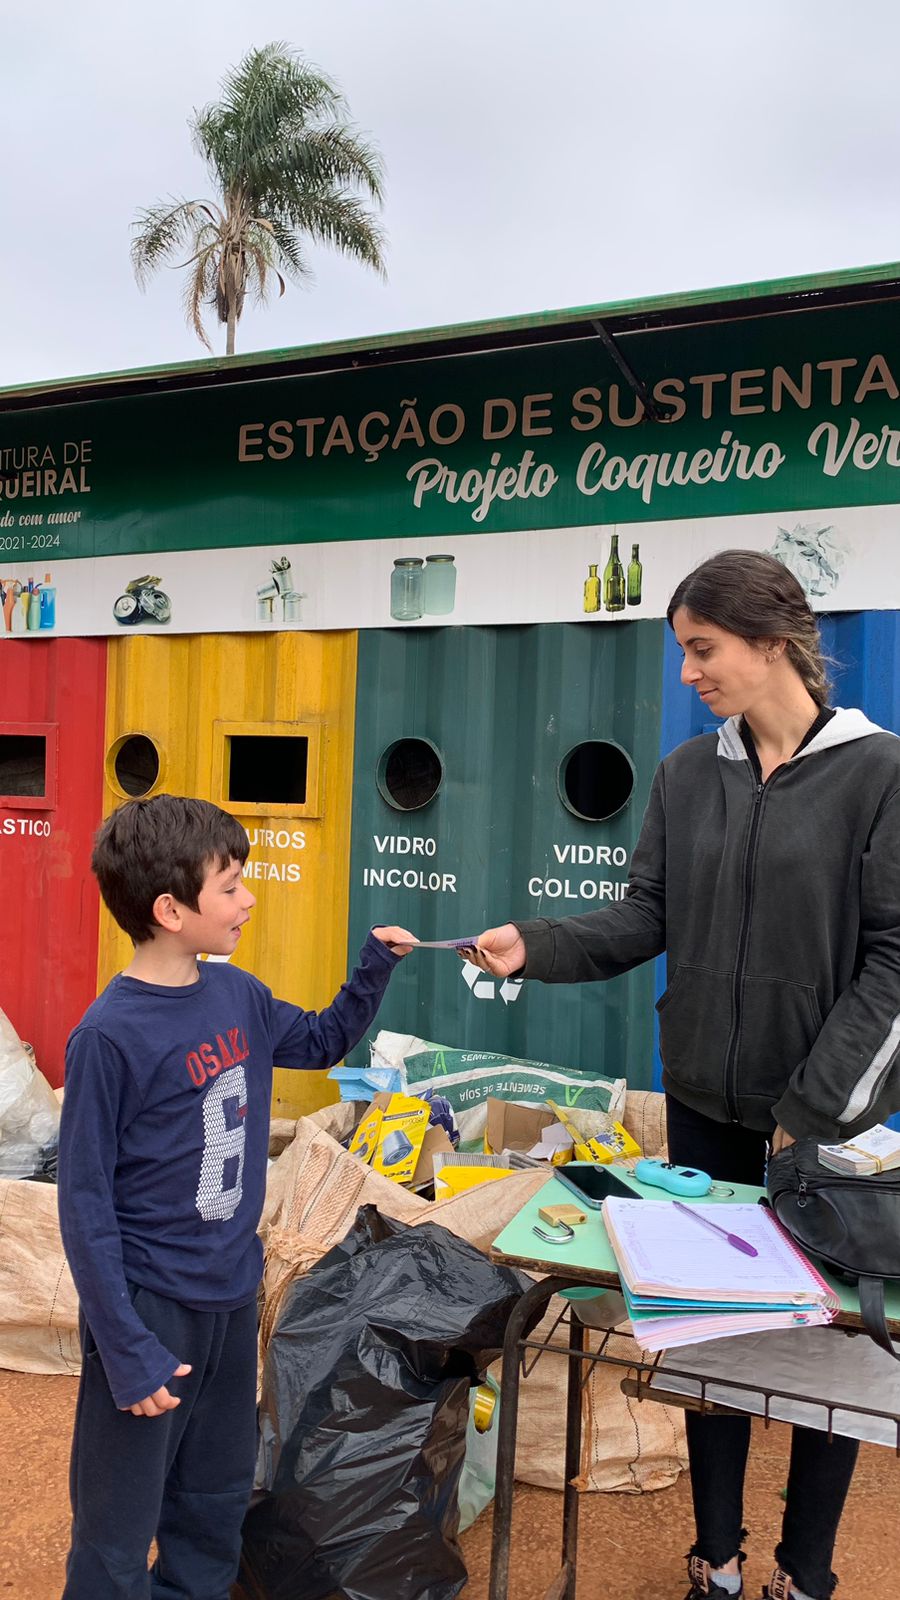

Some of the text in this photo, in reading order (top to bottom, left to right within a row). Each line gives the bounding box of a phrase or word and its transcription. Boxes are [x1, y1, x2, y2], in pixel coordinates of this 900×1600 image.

[238, 354, 900, 462] ESTAÇÃO DE SUSTENTA
[64, 440, 92, 464] DE
[406, 417, 900, 522] Projeto Coqueiro Ver
[0, 466, 91, 500] UEIRAL
[19, 514, 43, 527] com
[48, 511, 82, 525] amor
[0, 534, 61, 550] 2021-2024
[0, 818, 51, 837] STICO
[374, 835, 436, 857] VIDRO
[553, 844, 627, 867] VIDRO
[242, 861, 301, 882] METAIS
[363, 868, 457, 892] INCOLOR
[496, 1082, 547, 1095] SEMENTE
